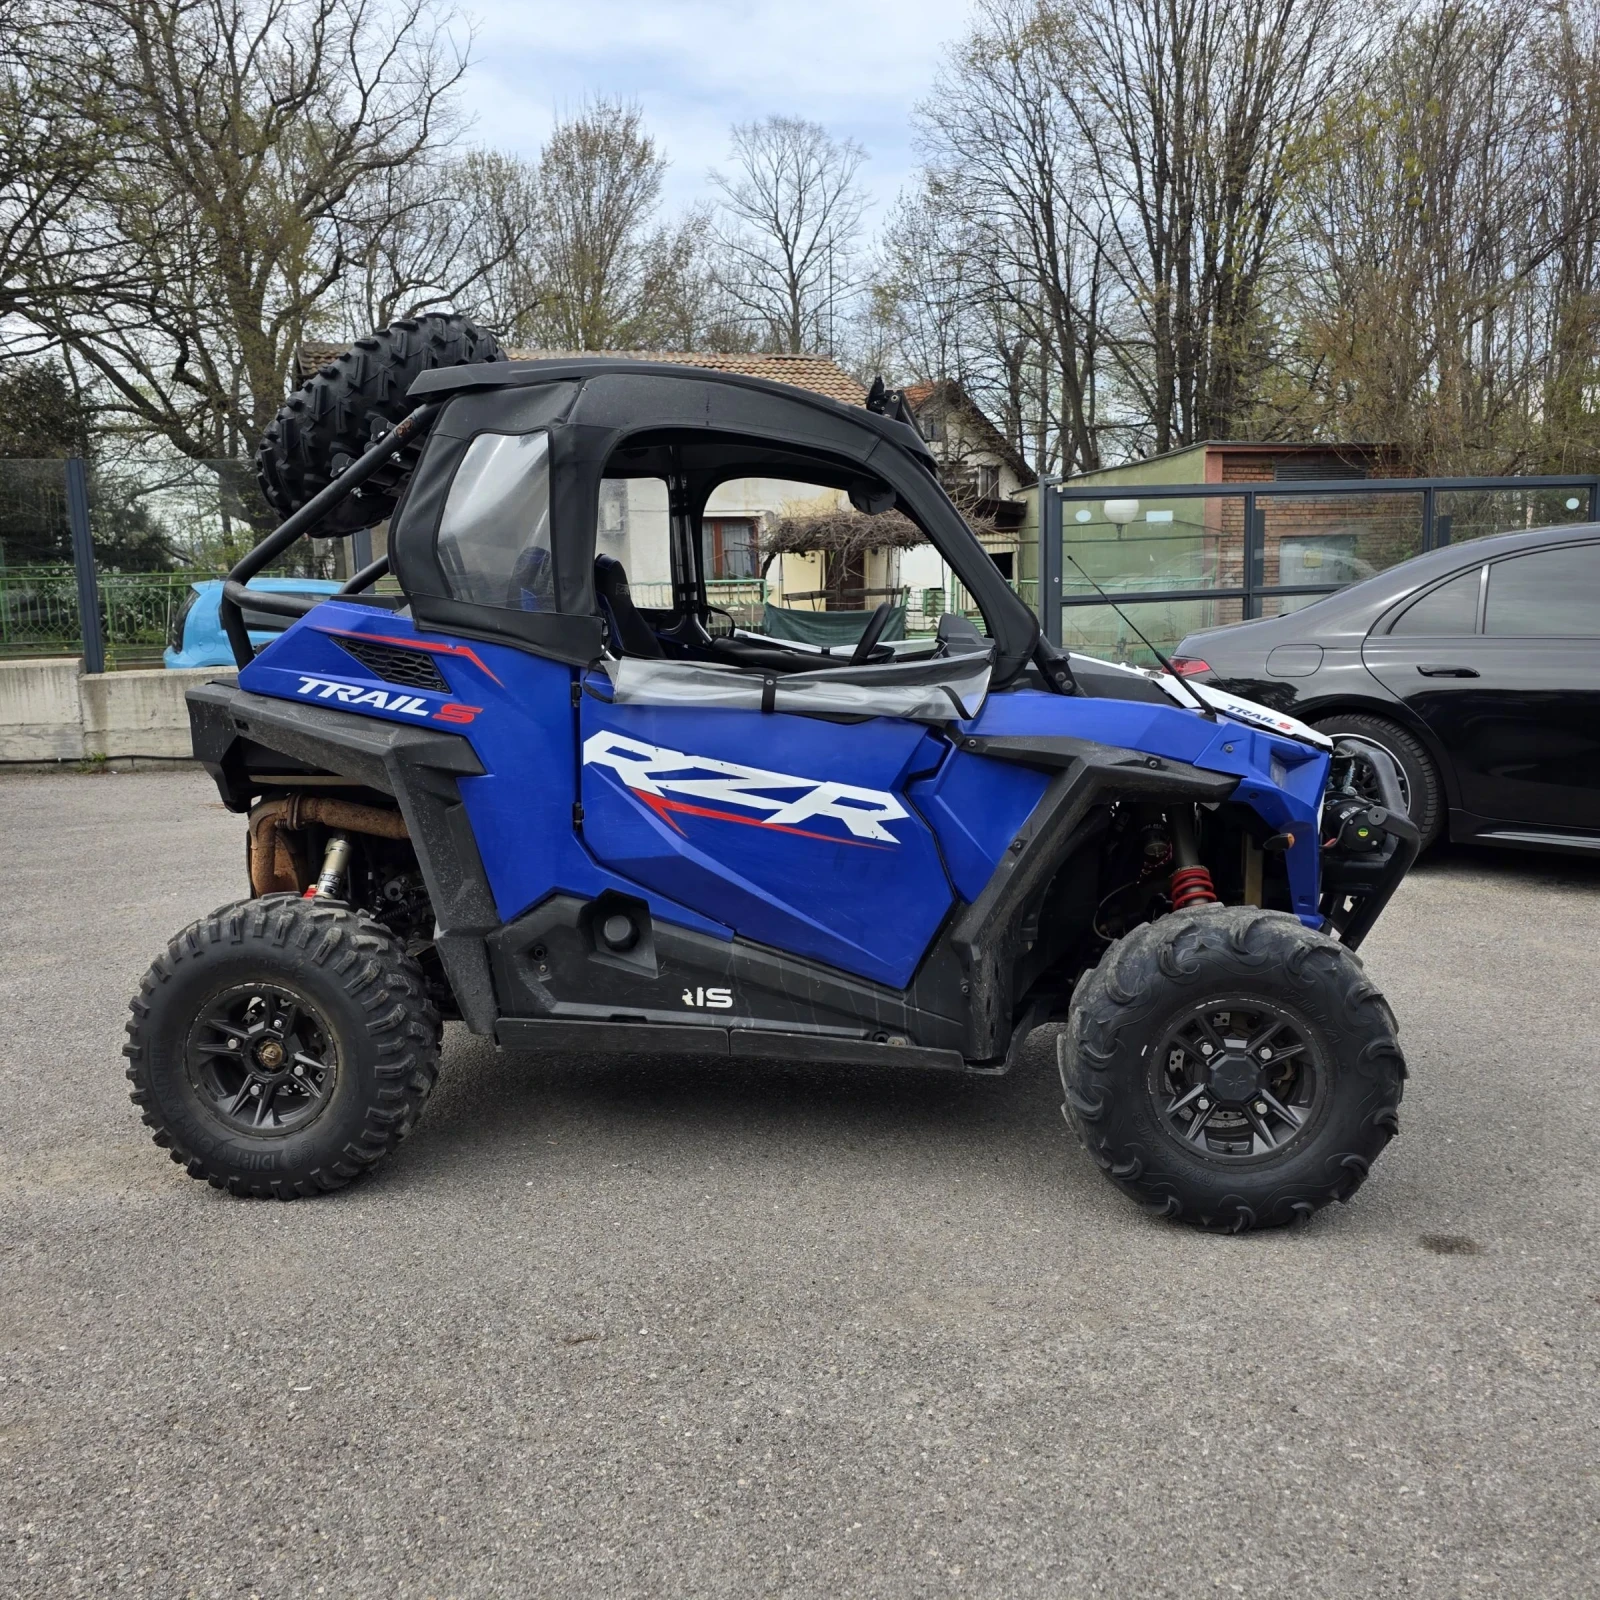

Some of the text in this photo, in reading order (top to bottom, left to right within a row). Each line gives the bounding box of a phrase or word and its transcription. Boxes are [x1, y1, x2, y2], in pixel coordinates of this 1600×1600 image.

[297, 676, 484, 724] TRAIL S
[1227, 704, 1294, 730] TRAIL S
[582, 729, 911, 844] RZR
[230, 1149, 277, 1171] DIRT
